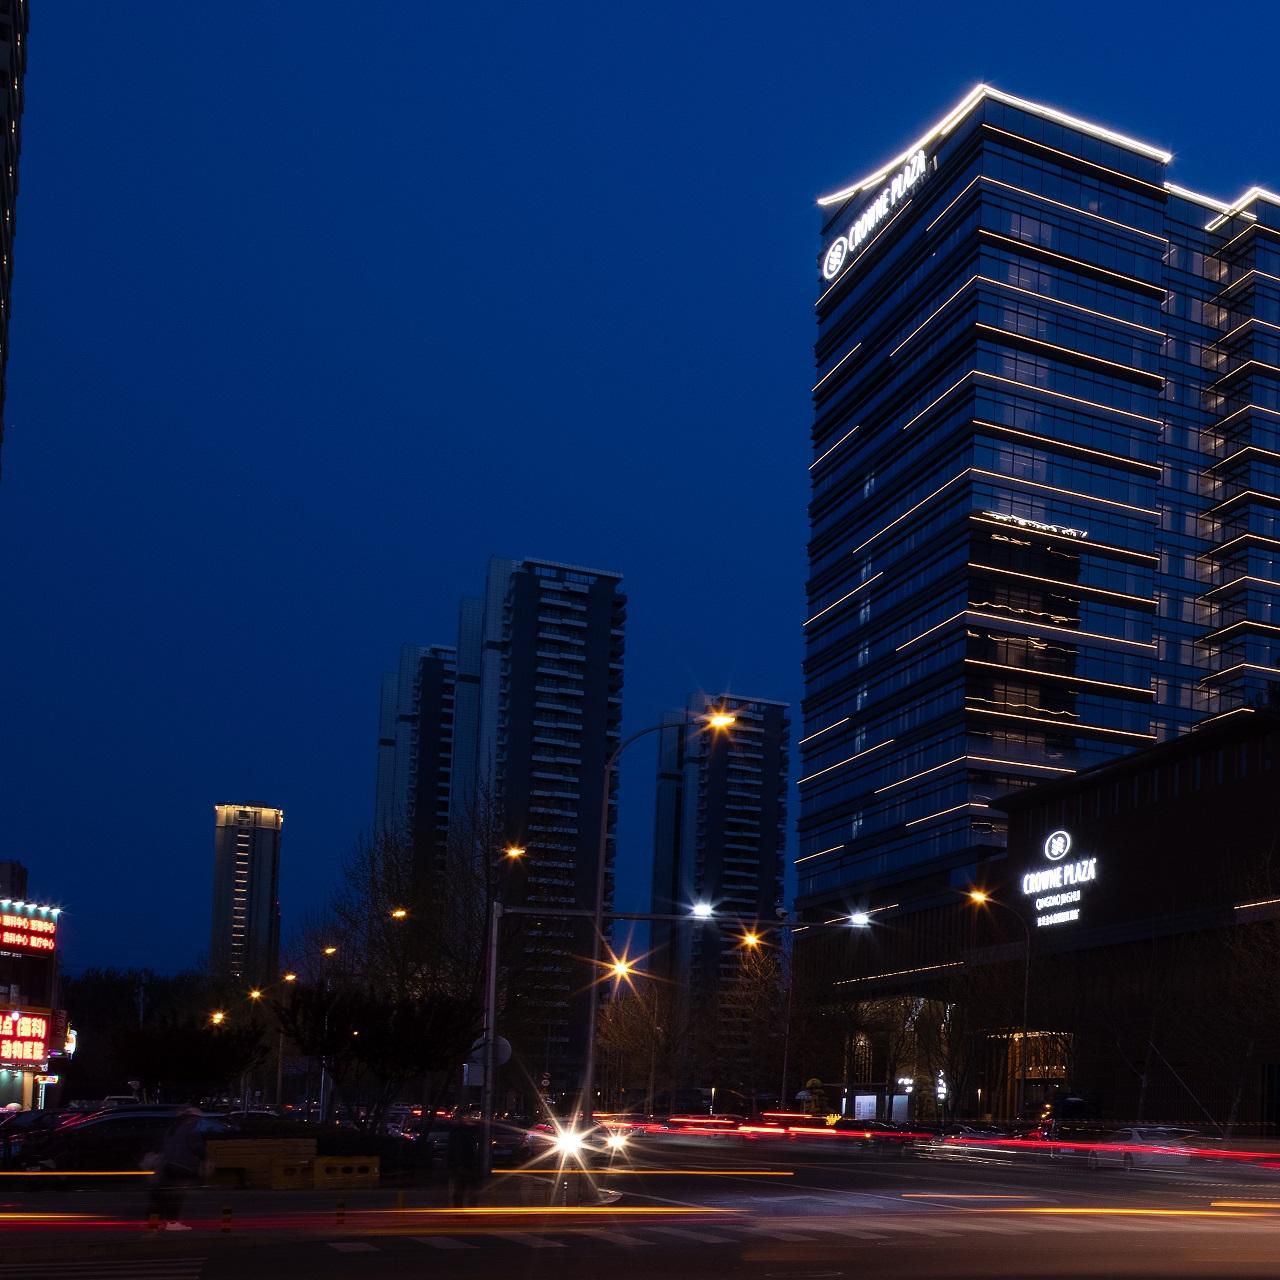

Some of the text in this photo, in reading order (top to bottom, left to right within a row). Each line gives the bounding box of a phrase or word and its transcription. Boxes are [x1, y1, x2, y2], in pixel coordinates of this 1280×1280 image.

[848, 149, 927, 252] CROWNE PLAZA
[1023, 858, 1097, 895] CROWNE PLAZA
